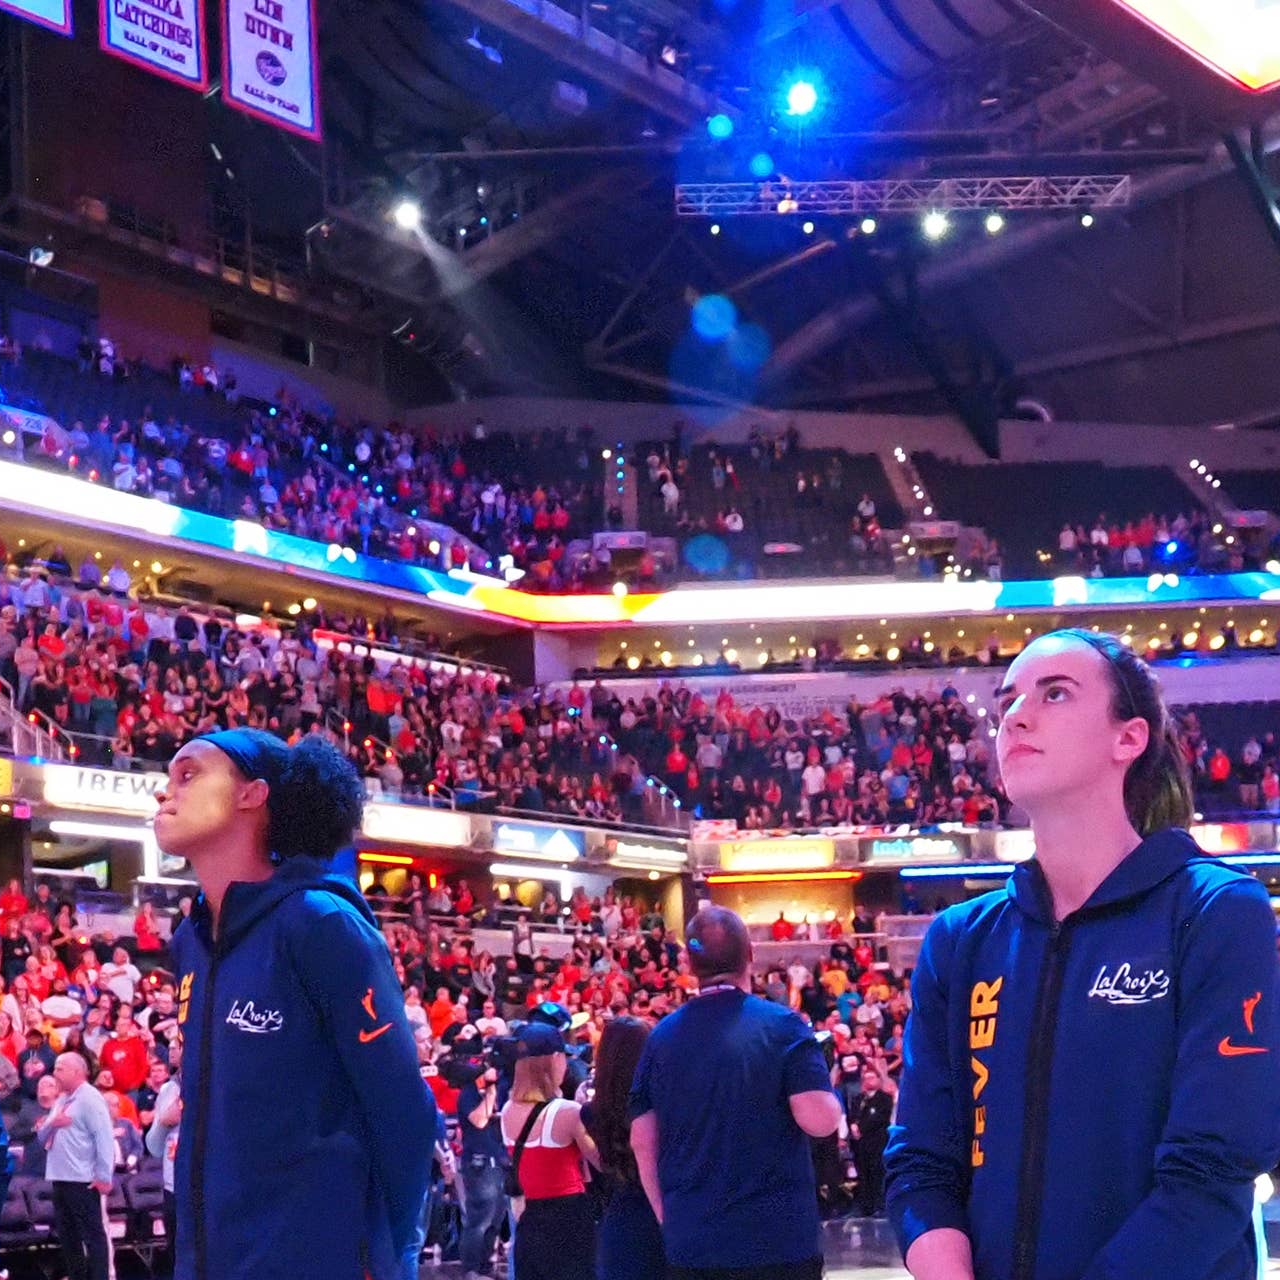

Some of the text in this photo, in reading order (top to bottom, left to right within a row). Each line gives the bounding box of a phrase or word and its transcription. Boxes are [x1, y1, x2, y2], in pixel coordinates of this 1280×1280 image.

[244, 12, 294, 51] DUNN
[76, 770, 158, 797] IBEW
[969, 976, 1004, 1167] FEVER
